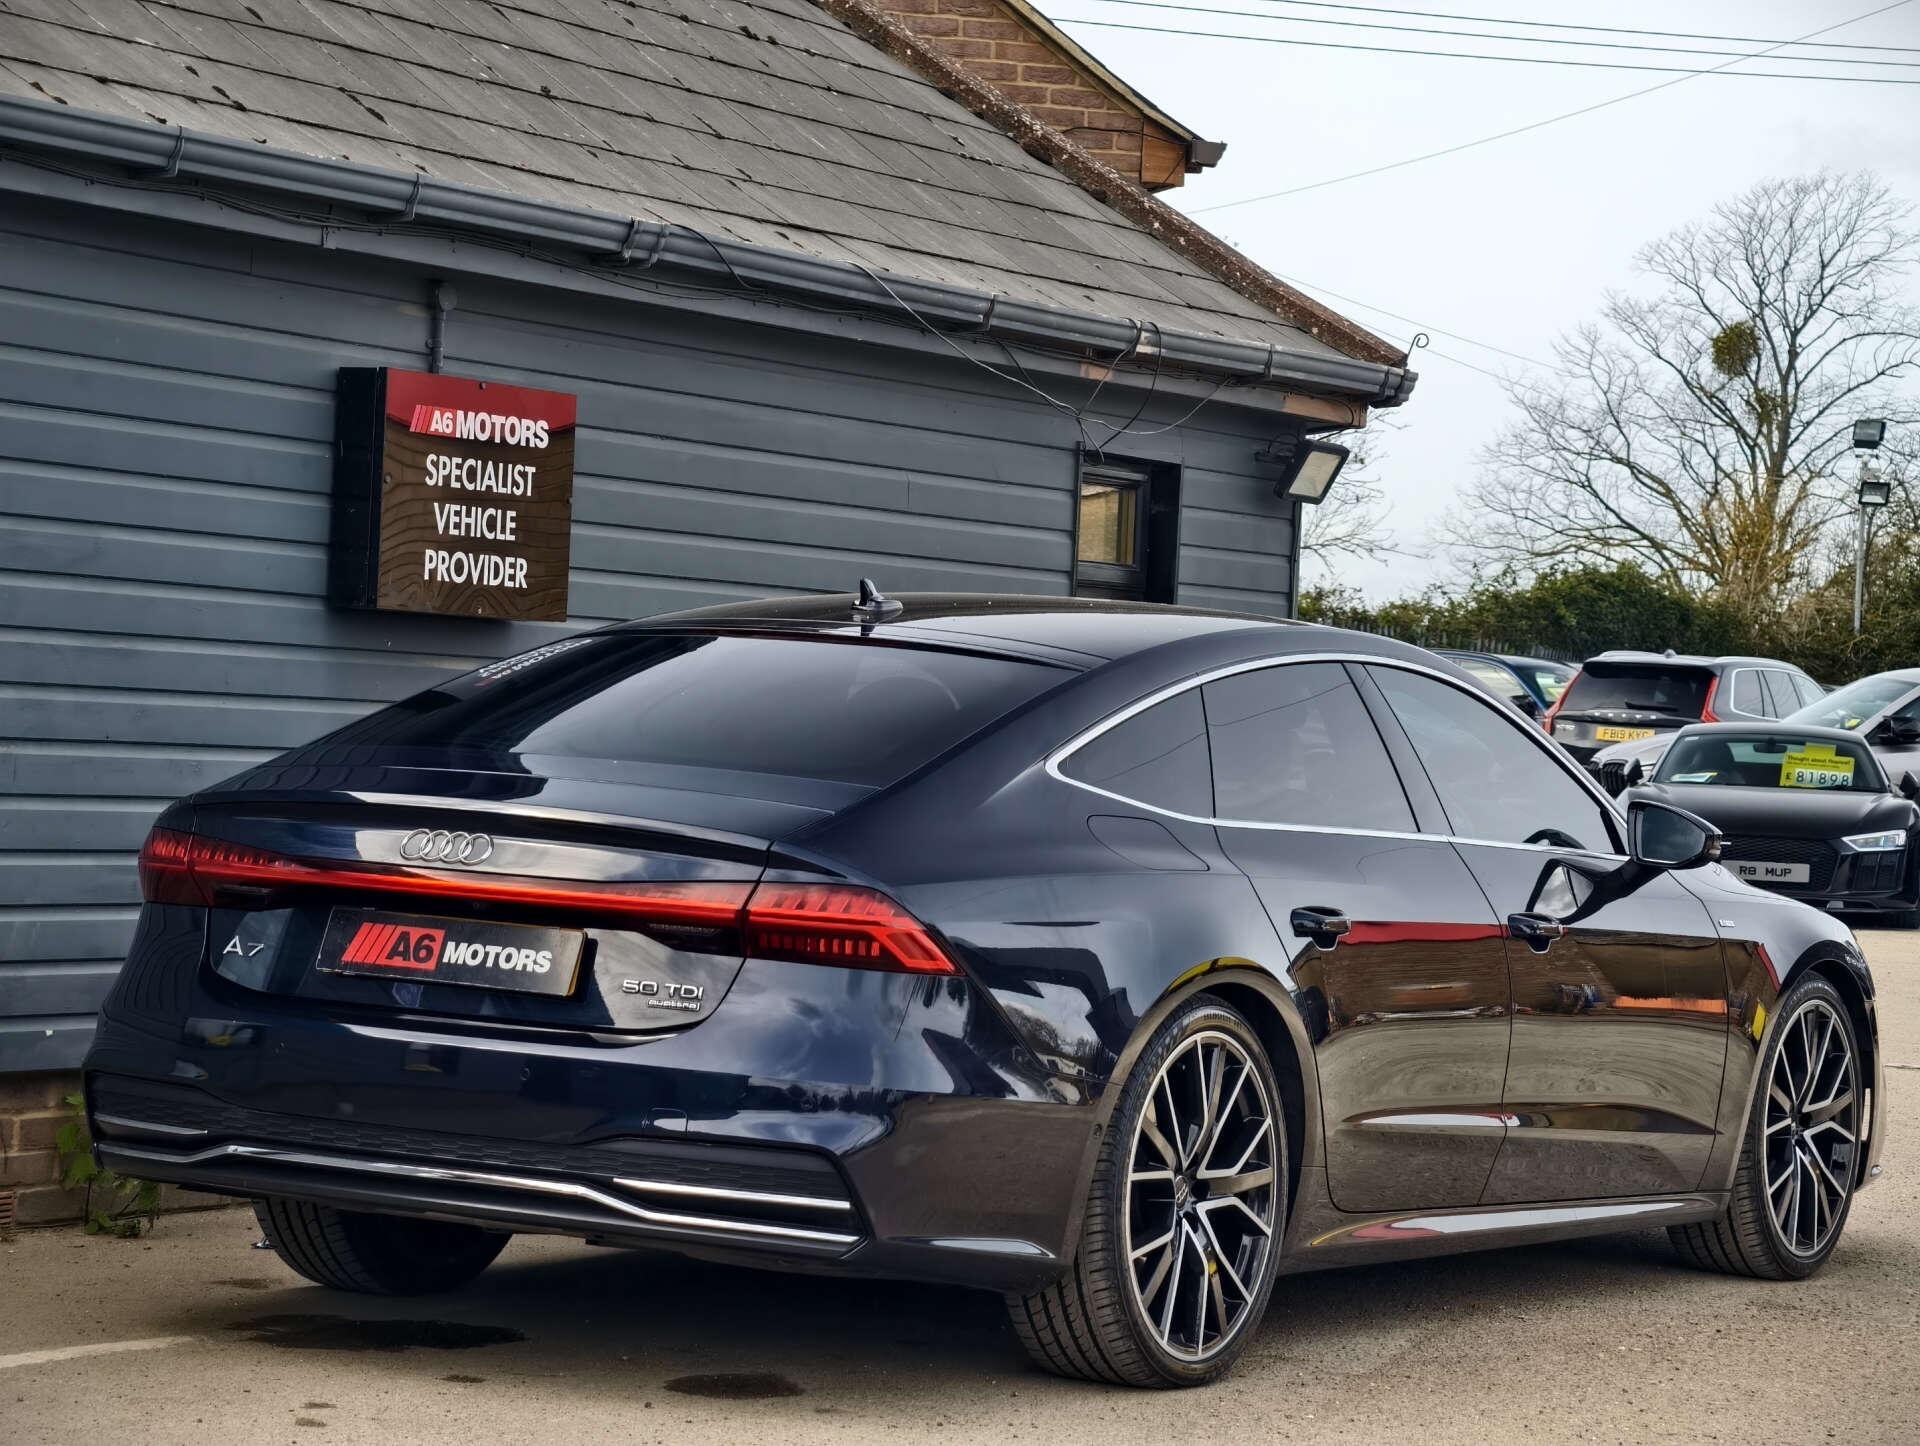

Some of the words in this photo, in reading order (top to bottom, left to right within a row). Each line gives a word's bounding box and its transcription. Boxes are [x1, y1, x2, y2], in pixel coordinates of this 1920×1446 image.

[430, 409, 454, 434] A6
[455, 410, 549, 448] MOTORS
[425, 453, 536, 496] SPECIALIST
[433, 502, 517, 541] VEHICLE
[423, 548, 528, 589] PROVIDER
[1765, 867, 1792, 877] MUP
[223, 935, 265, 957] A7
[385, 931, 437, 964] A6
[442, 941, 553, 974] MOTORS
[622, 979, 658, 995] 50
[664, 983, 704, 1000] TDI
